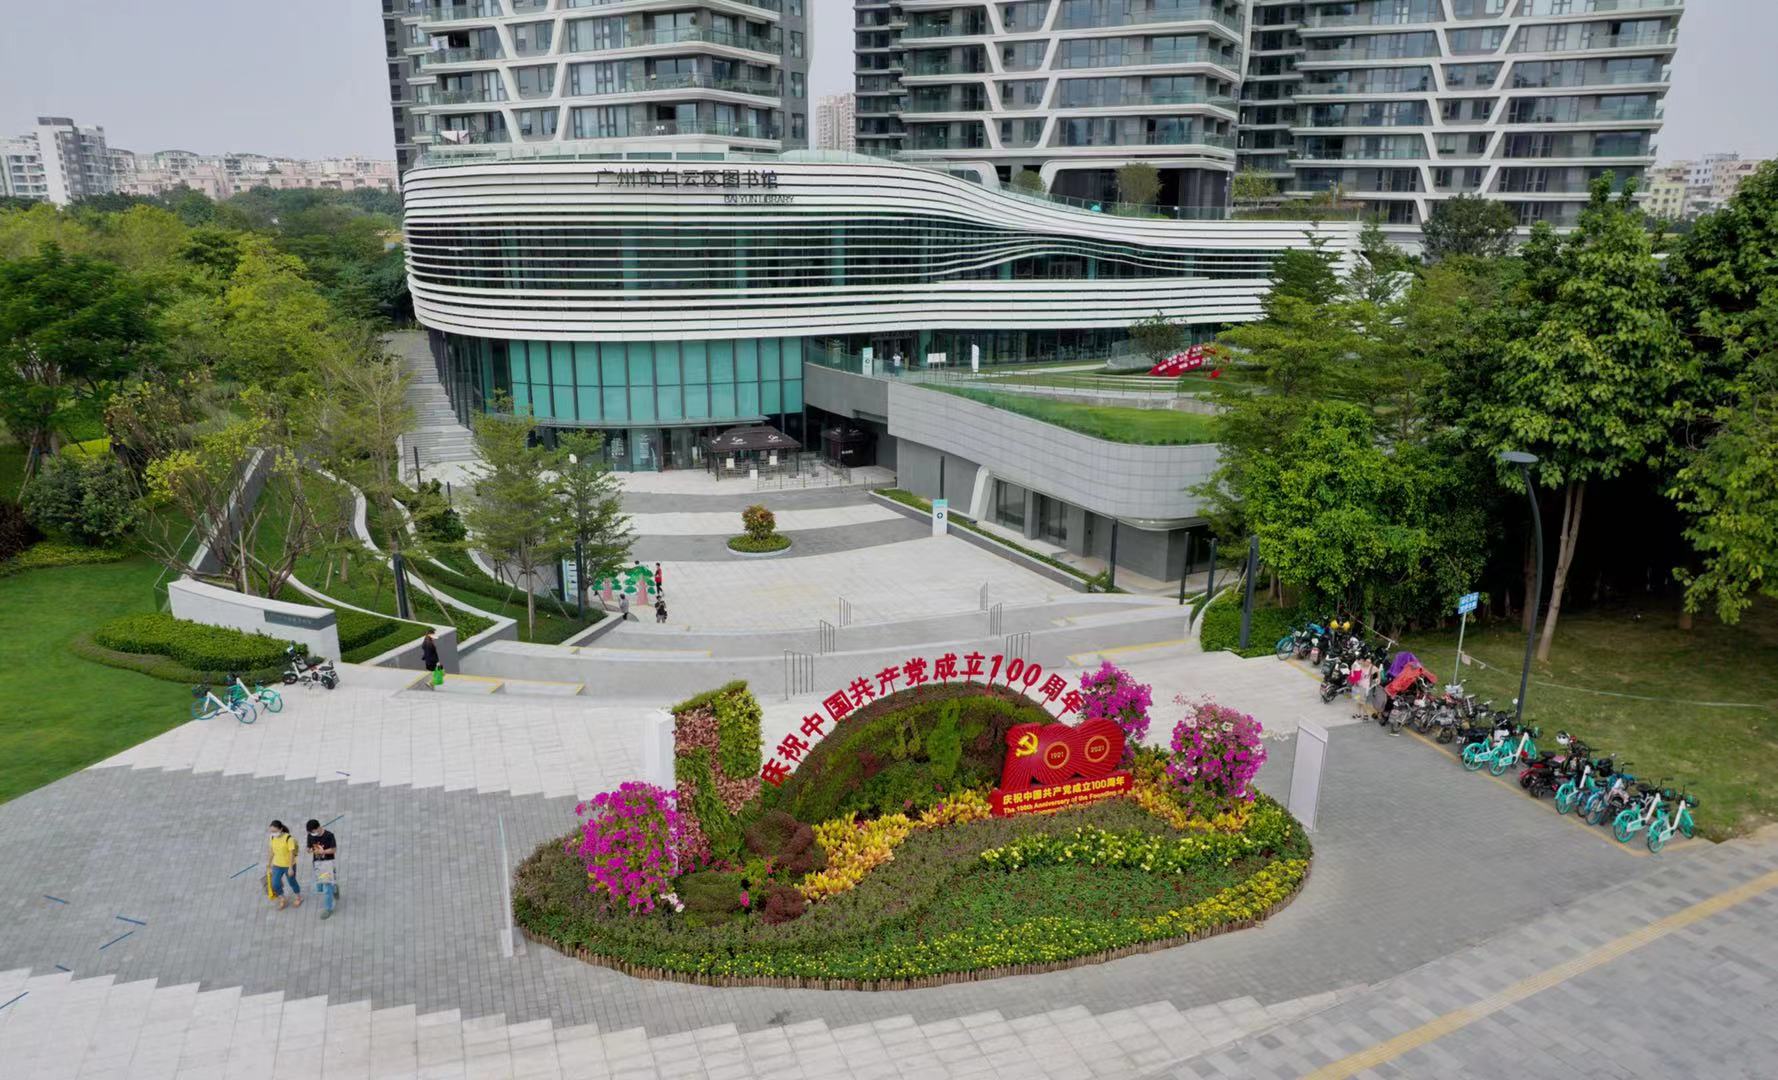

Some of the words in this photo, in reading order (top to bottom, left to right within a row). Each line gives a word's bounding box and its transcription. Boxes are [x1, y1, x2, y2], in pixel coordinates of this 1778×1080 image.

[595, 168, 778, 189] 广州市白云区图书馆
[761, 651, 1086, 787] 庆祝中国共产党成立100周年
[1050, 751, 1064, 760] 1921
[1090, 745, 1105, 753] 2021
[1003, 776, 1125, 805] 庆祝中国共产党成立100周年
[1034, 798, 1070, 809] Anniversary
